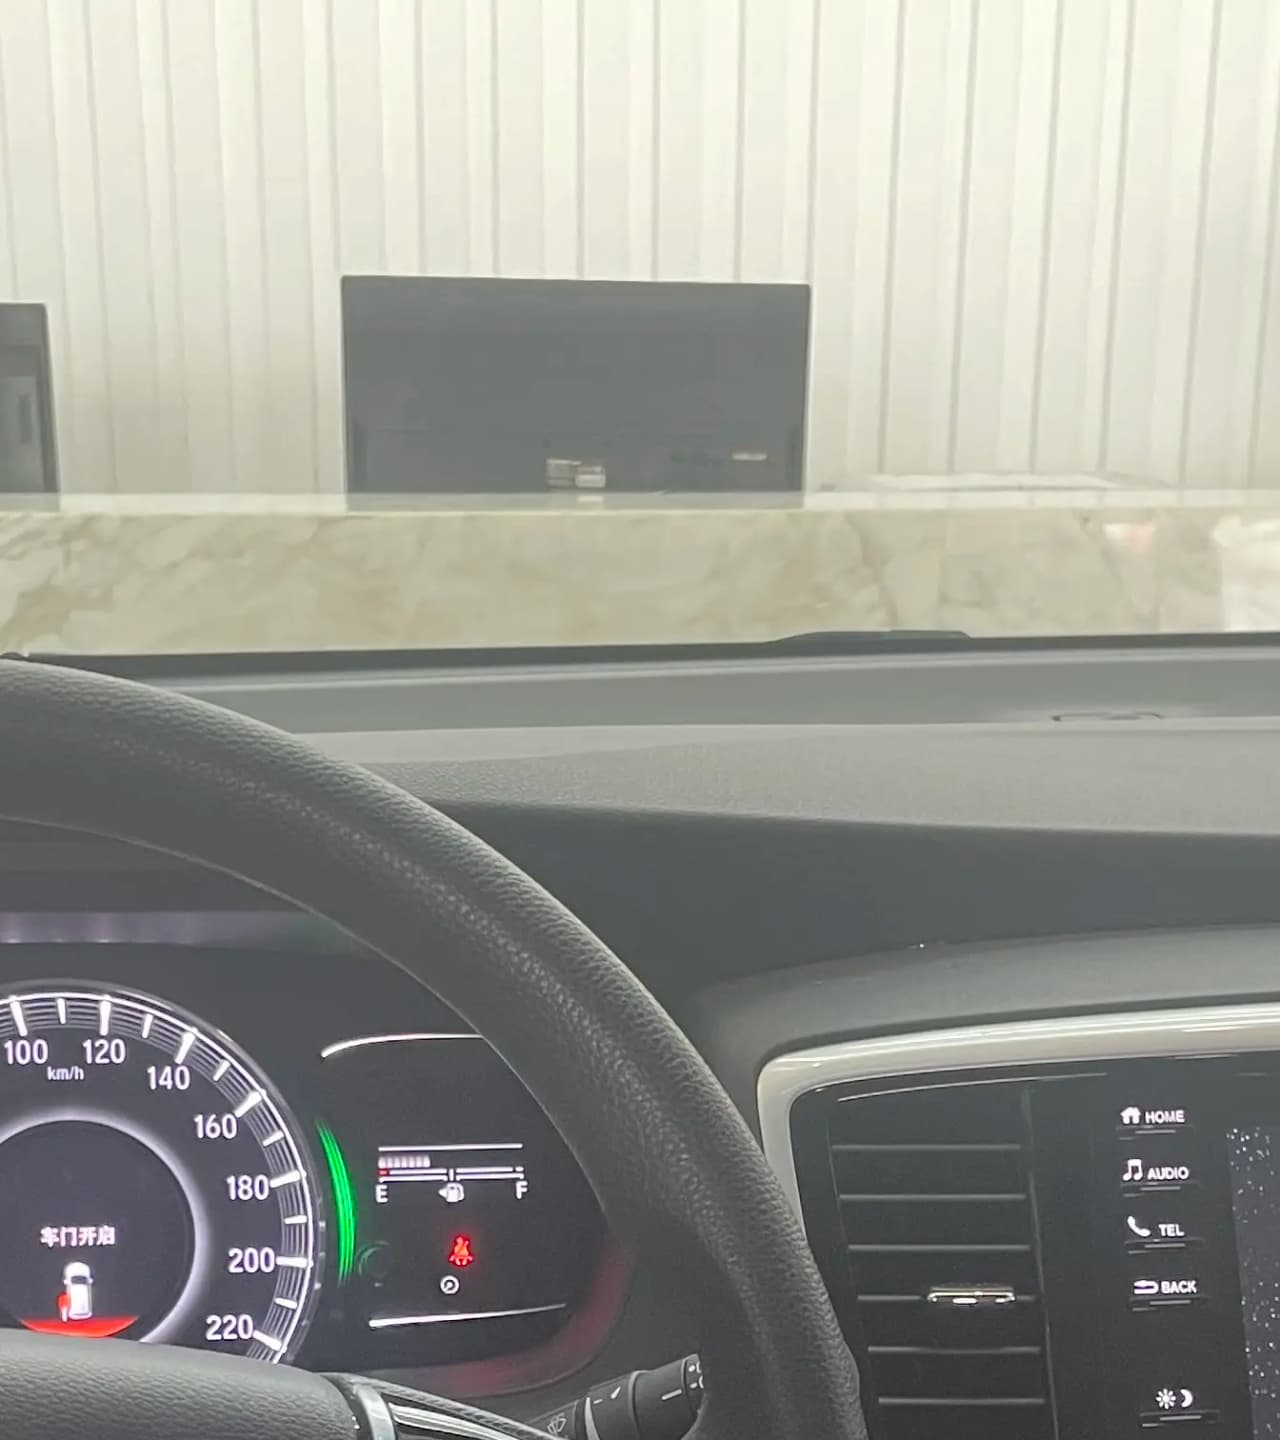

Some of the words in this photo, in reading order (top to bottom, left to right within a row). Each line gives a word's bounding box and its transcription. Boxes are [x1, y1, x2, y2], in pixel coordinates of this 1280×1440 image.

[4, 1039, 49, 1064] 100
[82, 1039, 126, 1063] 120
[46, 1065, 84, 1081] km/h
[147, 1065, 191, 1090] 140
[193, 1114, 238, 1139] 160
[1145, 1110, 1185, 1124] HOME
[1147, 1166, 1189, 1181] AUDIO
[226, 1175, 269, 1201] 180
[376, 1185, 388, 1203] E
[516, 1181, 528, 1199] F
[40, 1227, 116, 1246] 车门开启
[1159, 1224, 1184, 1238] TEL
[228, 1248, 275, 1273] 200
[1161, 1280, 1198, 1295] BACK
[206, 1315, 253, 1340] 220
